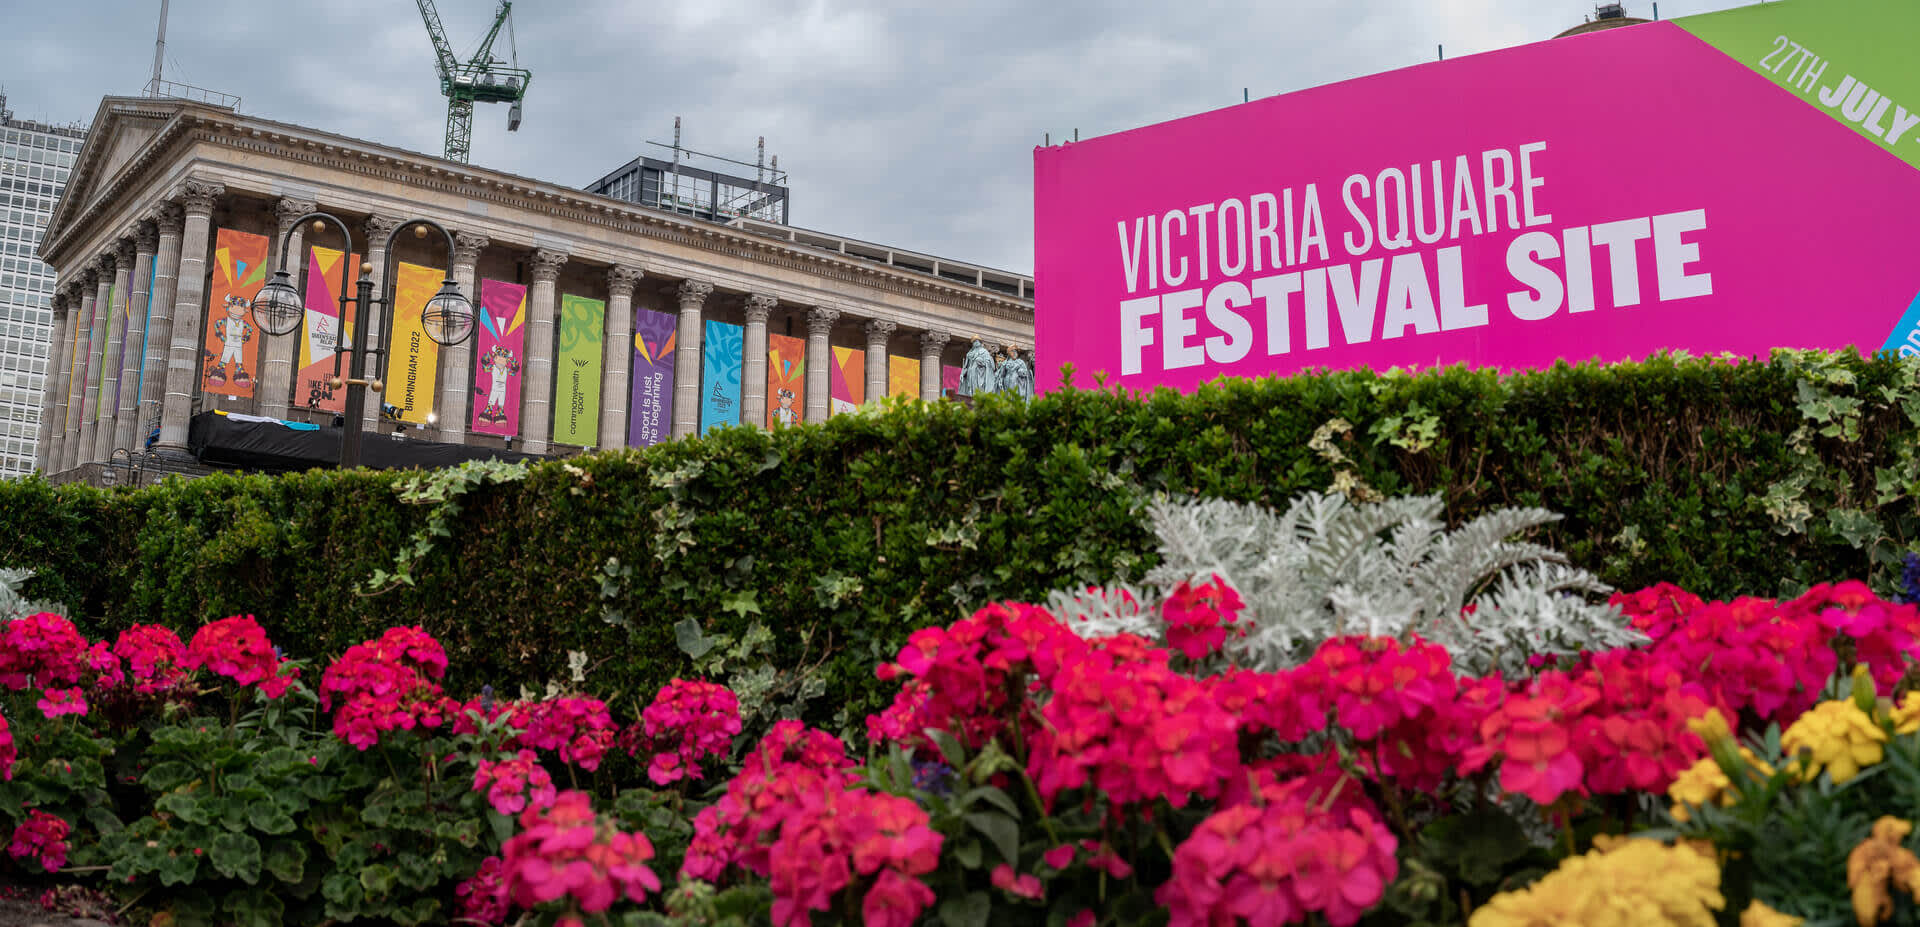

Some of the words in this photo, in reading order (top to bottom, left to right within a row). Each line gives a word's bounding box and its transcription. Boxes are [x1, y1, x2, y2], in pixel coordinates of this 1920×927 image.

[1759, 35, 1829, 94] 27TH
[1818, 74, 1920, 146] JULY
[1117, 183, 1330, 293] VICTORIA
[1342, 141, 1553, 256] SQUARE
[1119, 246, 1489, 376] FESTIVAL
[1505, 208, 1714, 321] SITE
[410, 331, 420, 354] 2022
[405, 355, 418, 412] BIRMINGHAM
[642, 398, 651, 408] is
[643, 376, 652, 396] just
[650, 372, 663, 426] beginning
[641, 411, 650, 440] sport
